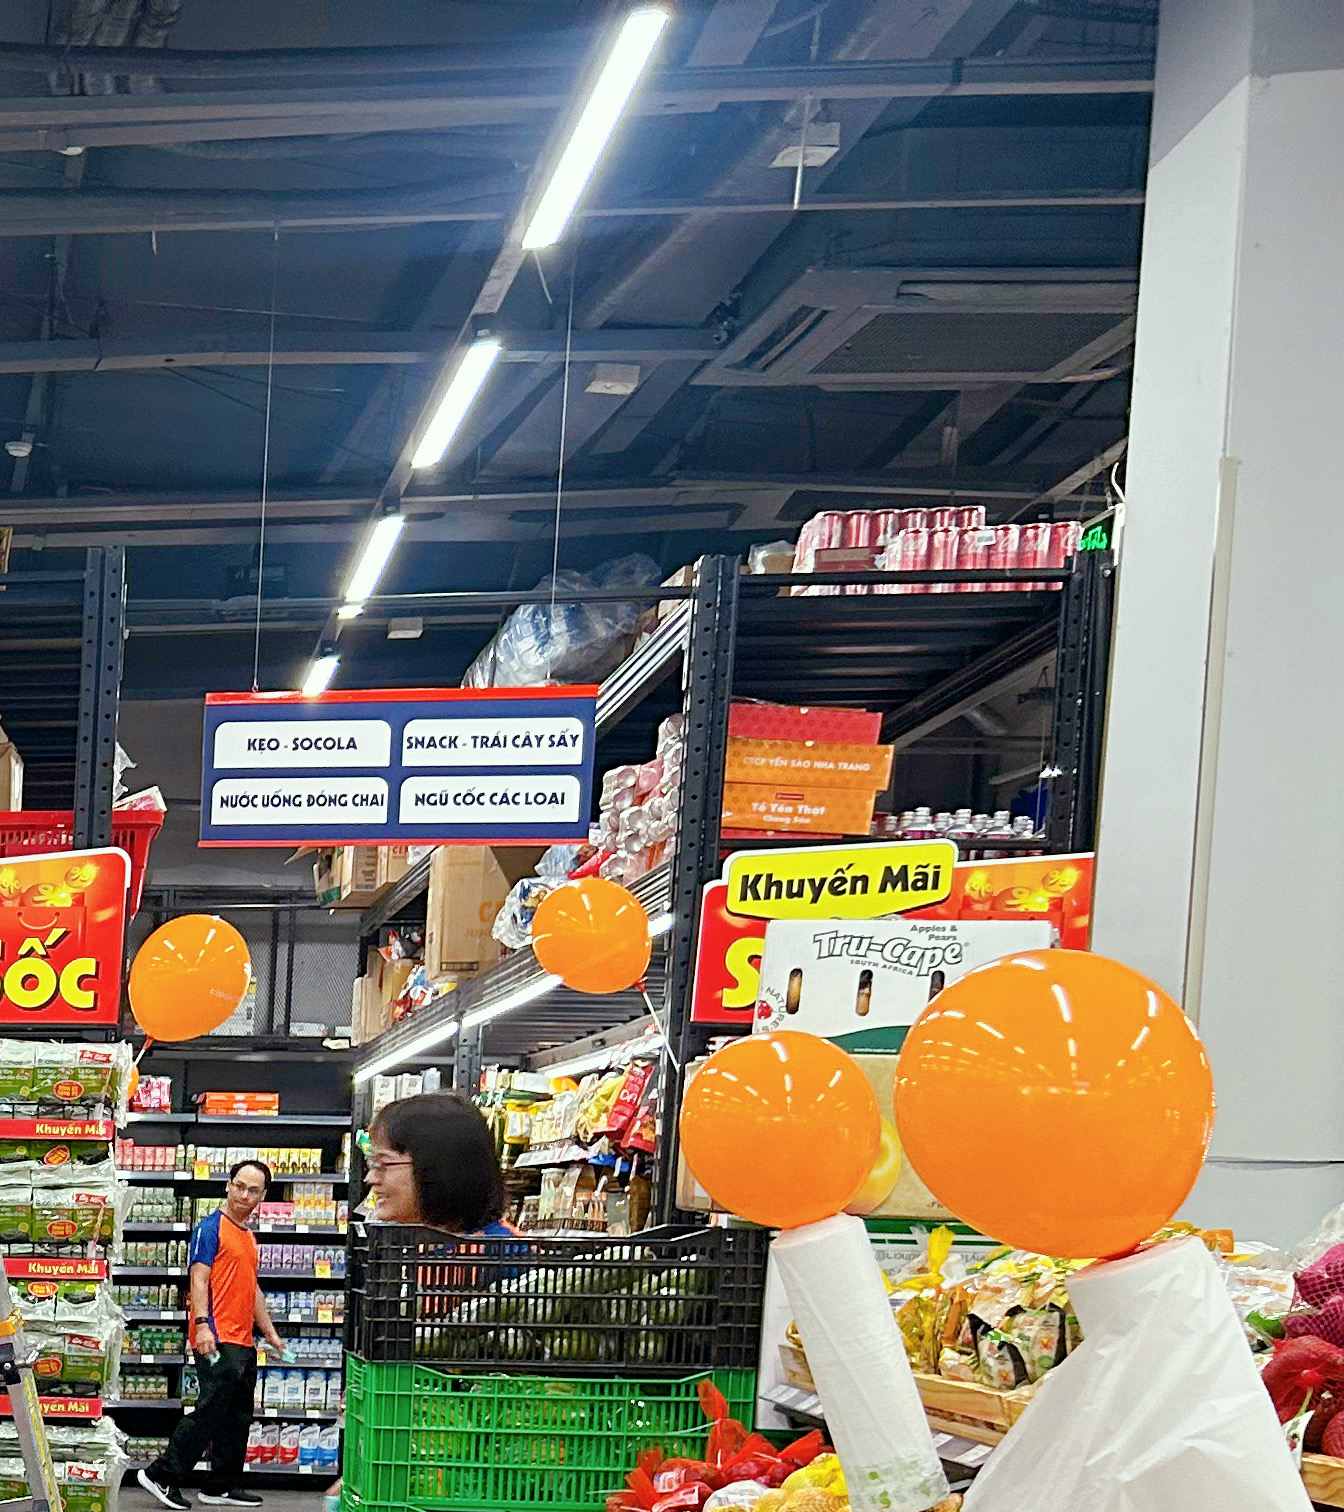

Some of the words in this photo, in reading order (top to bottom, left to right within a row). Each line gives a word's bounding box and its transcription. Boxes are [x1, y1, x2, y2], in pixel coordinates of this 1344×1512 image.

[247, 737, 280, 755] KẸO
[292, 736, 358, 751] SOCOLA
[406, 735, 459, 750] SNACK
[471, 731, 507, 749] TRÁI
[512, 730, 545, 749] CÂY
[548, 727, 579, 748] SẤY
[838, 762, 870, 771] TRANG
[219, 790, 258, 809] NƯỚC
[261, 788, 302, 809] UỐNG
[306, 790, 348, 808] ĐÓNG
[352, 792, 385, 807] CHAI
[414, 789, 448, 807] NGŨ
[453, 786, 485, 806] CỐC
[490, 789, 521, 806] CÁC
[524, 791, 565, 810] LOẠI
[739, 862, 869, 904] Khuyến
[879, 863, 941, 893] Mãi
[911, 924, 947, 933] Apples
[949, 924, 957, 932] &
[813, 929, 963, 977] Tru-Cape
[850, 958, 879, 969] SOUTH
[881, 962, 915, 976] AFRICA
[36, 1121, 82, 1136] Khuyến
[28, 1262, 74, 1275] Khuyến
[68, 1400, 89, 1413] Mãi
